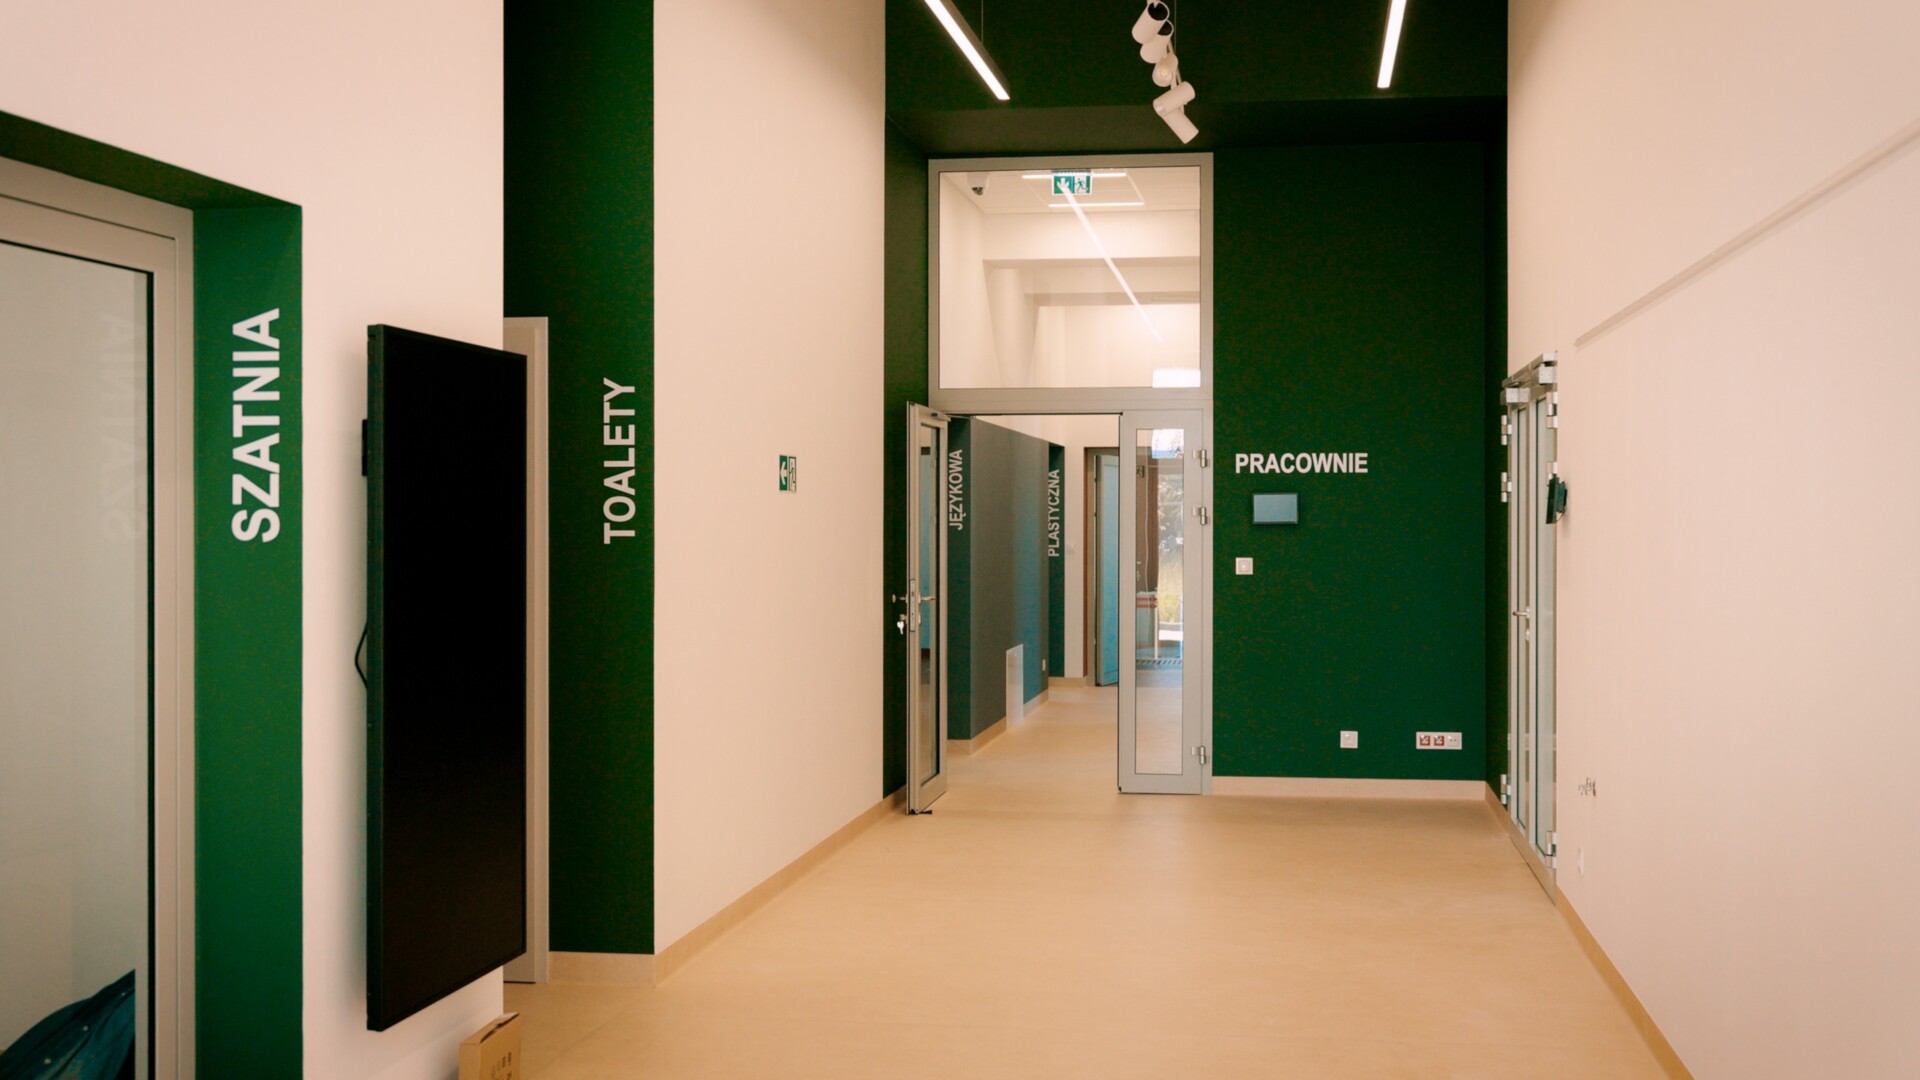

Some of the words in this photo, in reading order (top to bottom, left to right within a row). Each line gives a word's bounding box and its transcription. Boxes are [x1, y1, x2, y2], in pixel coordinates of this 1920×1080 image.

[231, 308, 280, 543] SZATNIA
[603, 377, 636, 544] TOALETY
[1235, 453, 1368, 474] PRACOWNIE
[949, 449, 966, 530] JĘZYKOWA
[1048, 469, 1060, 557] PLASTYCZNA
